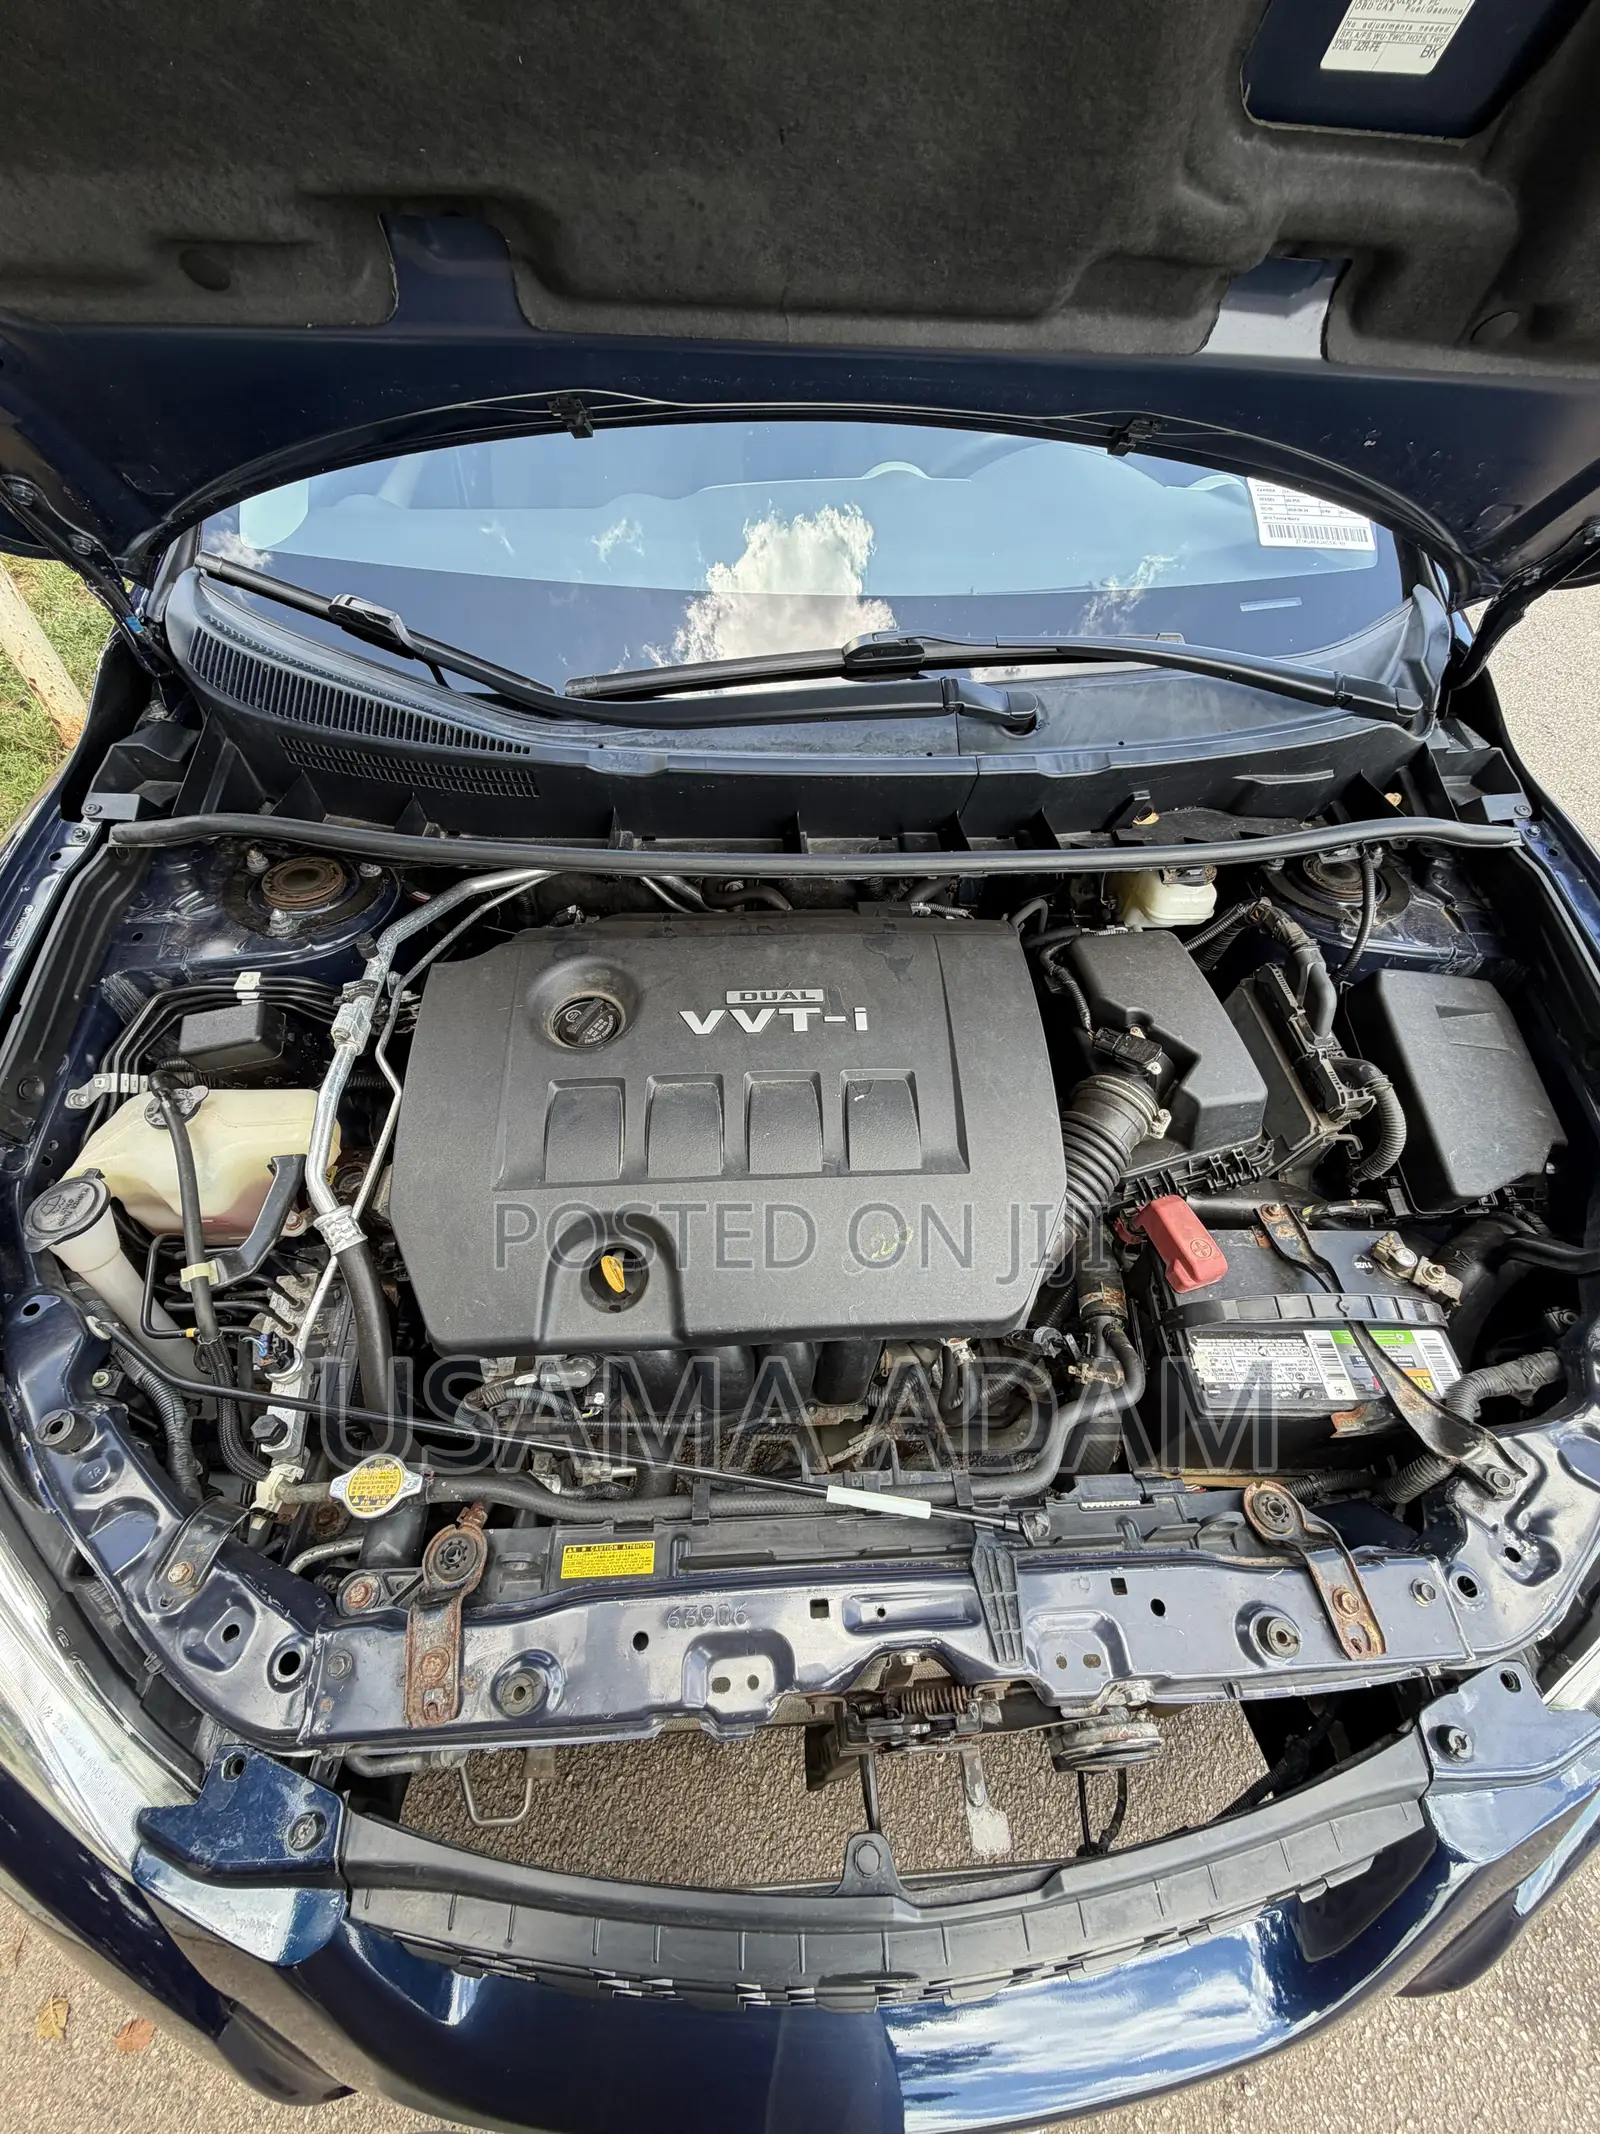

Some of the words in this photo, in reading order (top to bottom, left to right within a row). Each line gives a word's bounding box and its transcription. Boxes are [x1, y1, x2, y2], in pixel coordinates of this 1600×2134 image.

[1362, 21, 1413, 33] adjustments
[1420, 45, 1442, 59] BK
[737, 989, 818, 1003] DUAL
[678, 1007, 869, 1036] VVT-i
[621, 1542, 653, 1550] ATTENTION
[666, 1601, 749, 1629] 63906
